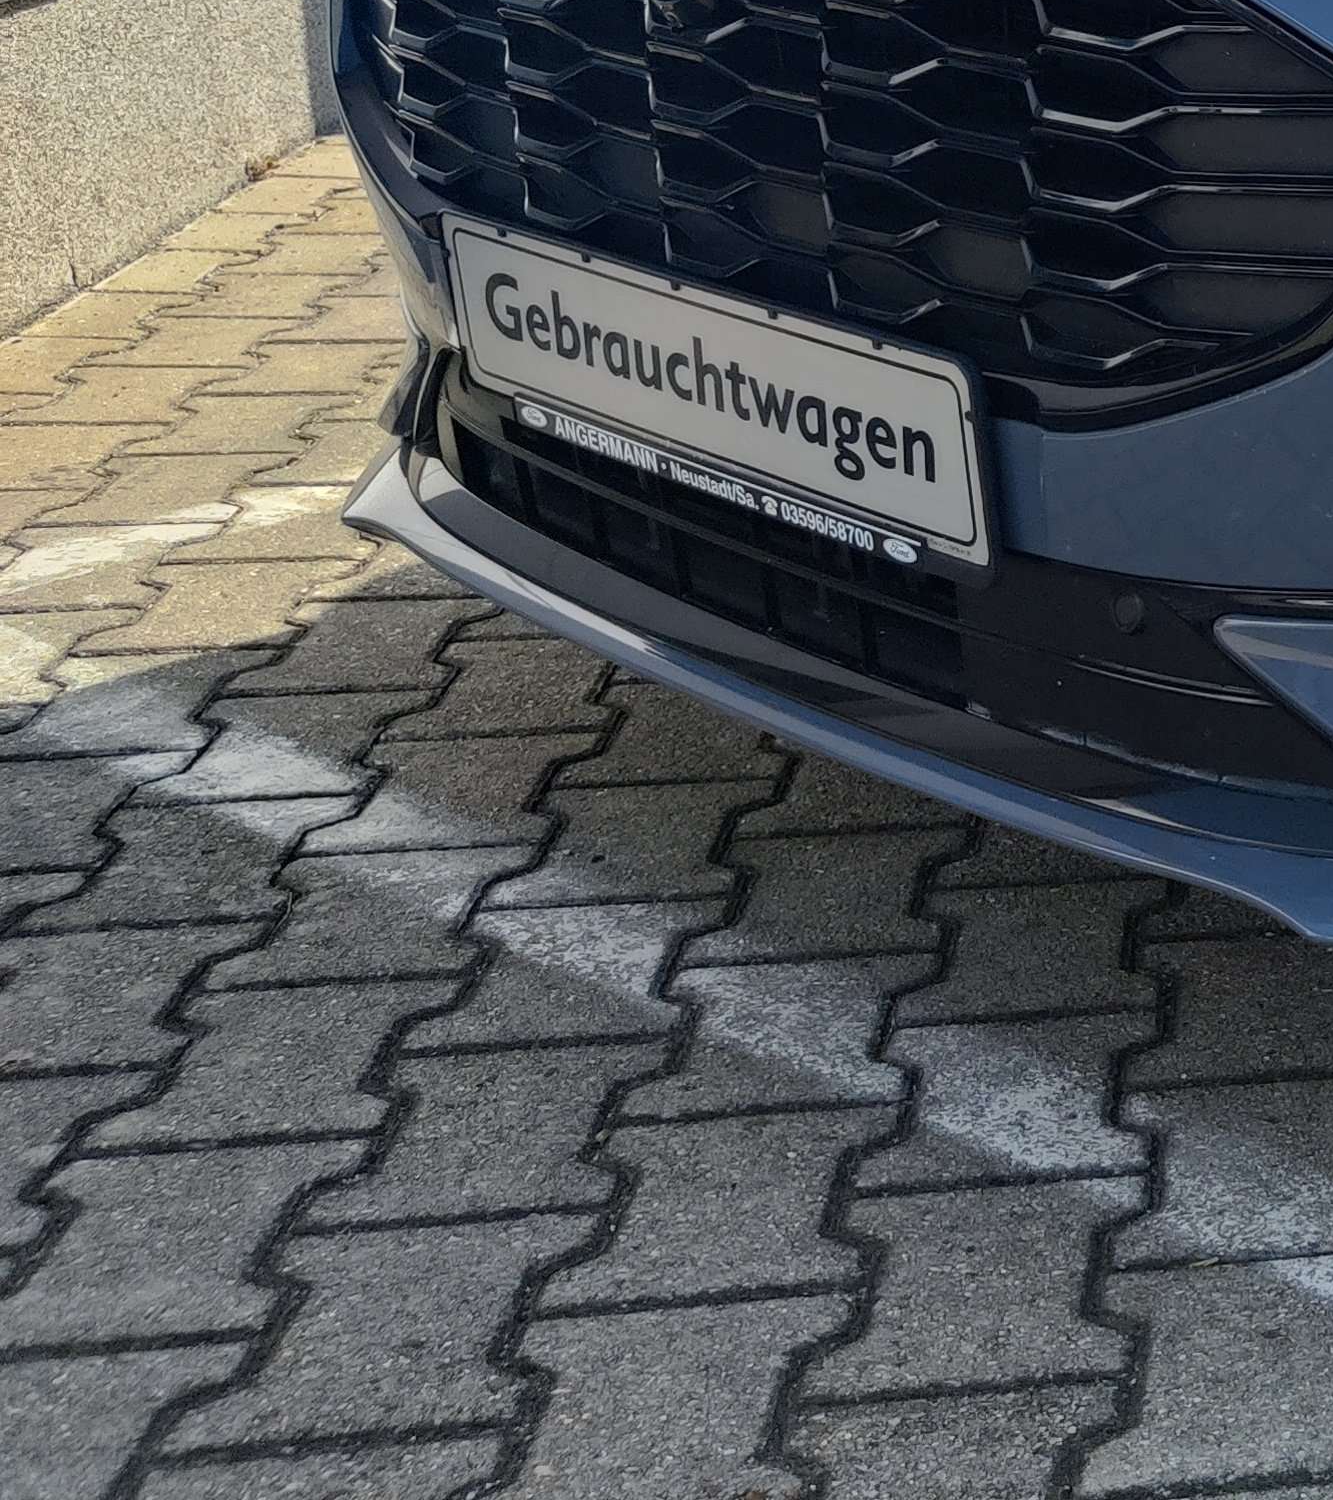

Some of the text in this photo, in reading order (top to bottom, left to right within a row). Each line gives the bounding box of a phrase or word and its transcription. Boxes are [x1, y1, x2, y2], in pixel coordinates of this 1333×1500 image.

[484, 273, 936, 483] Gebrauchtwagen
[555, 416, 659, 474] ANGERMANN
[780, 501, 875, 552] 03596/58700
